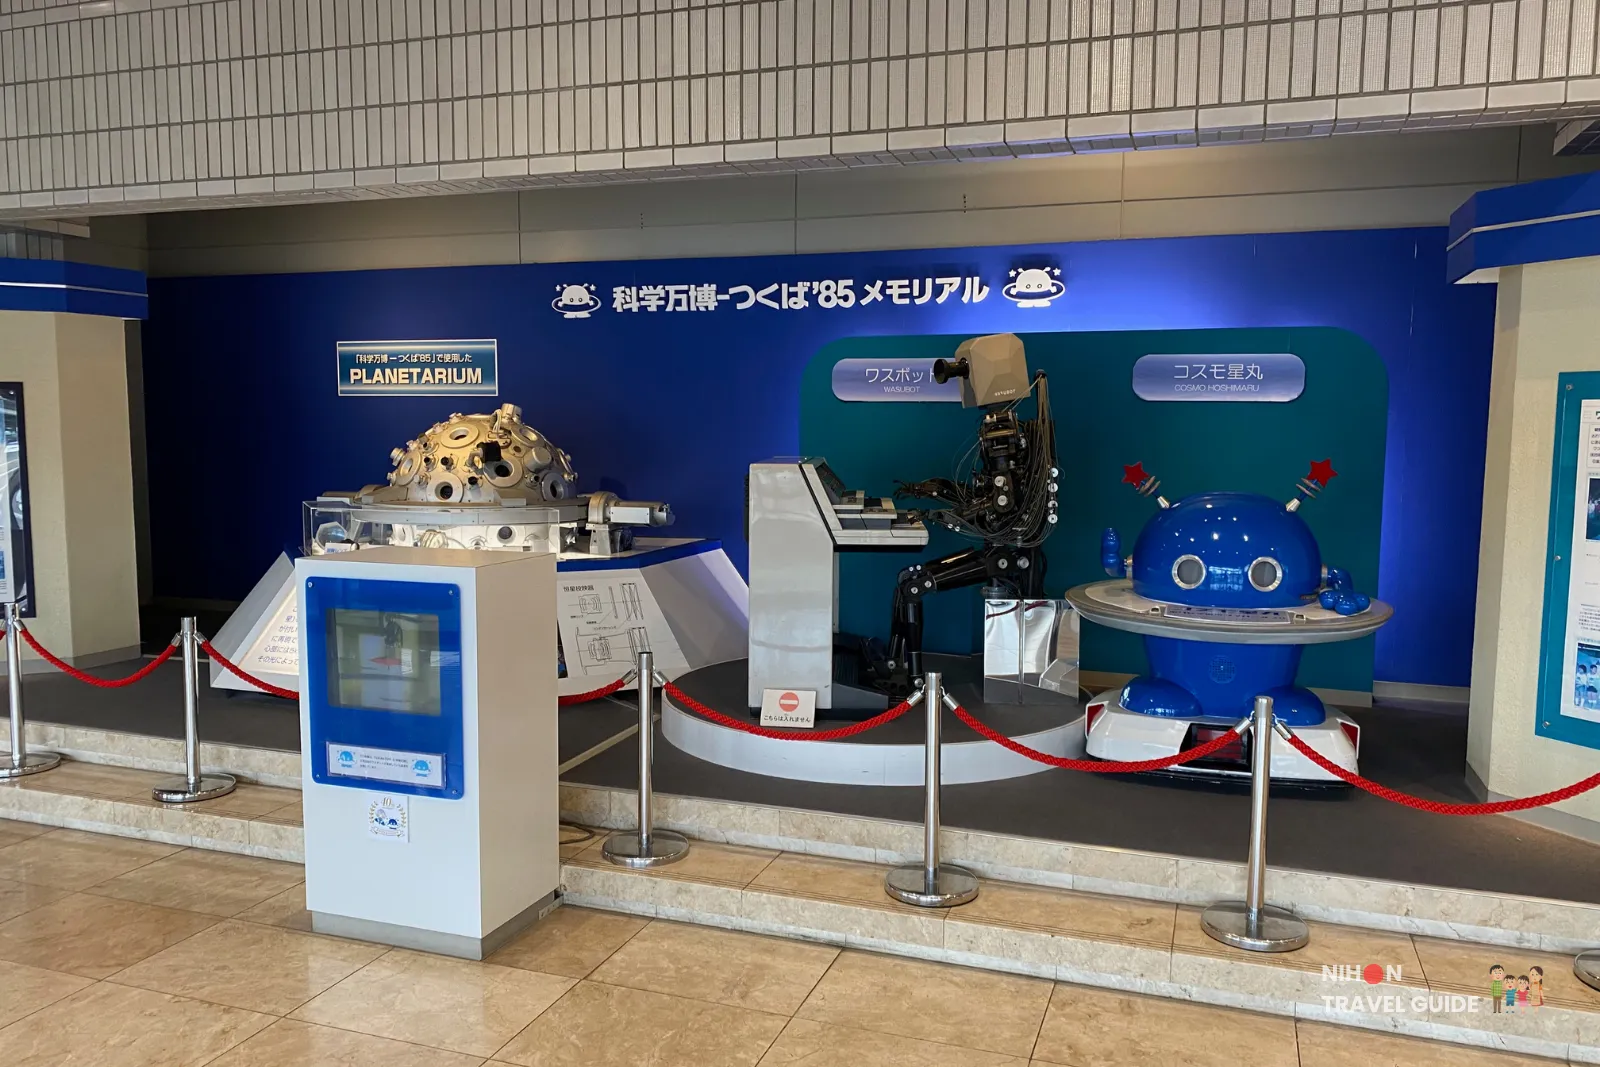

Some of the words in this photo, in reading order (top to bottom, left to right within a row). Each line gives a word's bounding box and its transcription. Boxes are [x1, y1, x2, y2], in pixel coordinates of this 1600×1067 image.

[350, 368, 482, 385] PLANETARIUM
[1173, 363, 1264, 380] コスモ星丸
[1174, 384, 1206, 392] COSMO
[1208, 384, 1260, 392] HOSHIMARU
[763, 715, 811, 723] こちらは入れません
